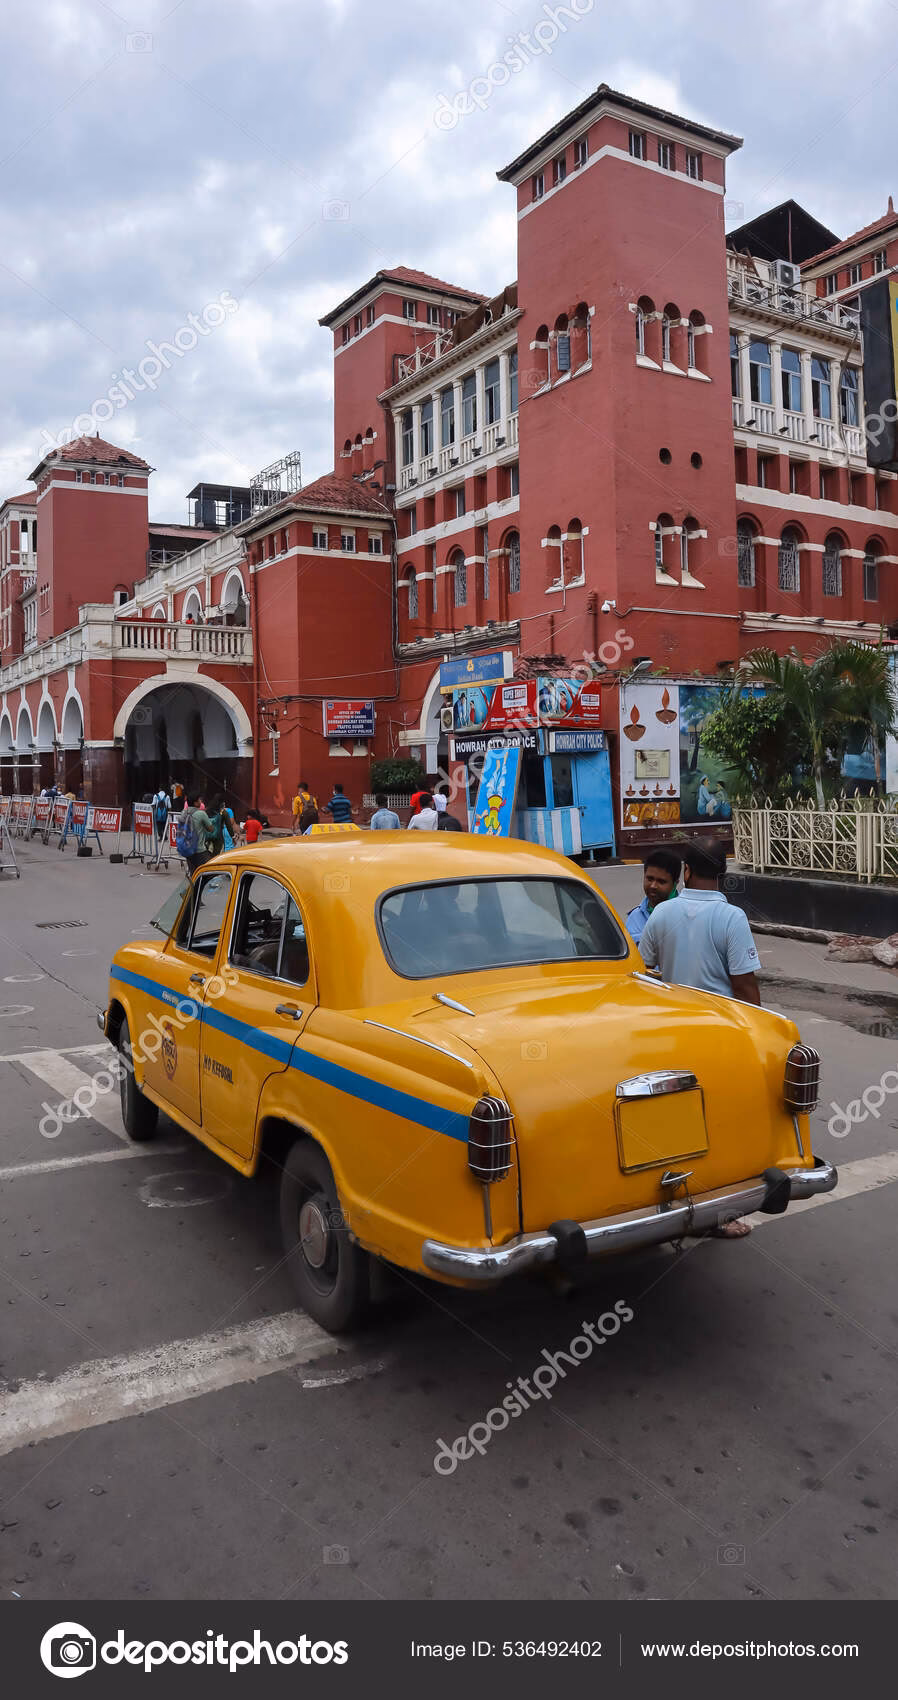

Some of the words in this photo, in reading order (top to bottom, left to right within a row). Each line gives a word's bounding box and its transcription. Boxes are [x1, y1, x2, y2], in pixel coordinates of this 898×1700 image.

[456, 741, 486, 752] HOWRAH
[488, 739, 505, 748] CITY
[556, 734, 575, 750] HOWRAH
[576, 733, 586, 749] CITY
[587, 733, 603, 749] POLICE
[99, 812, 118, 825] DOLLAR
[203, 1053, 211, 1071] NO
